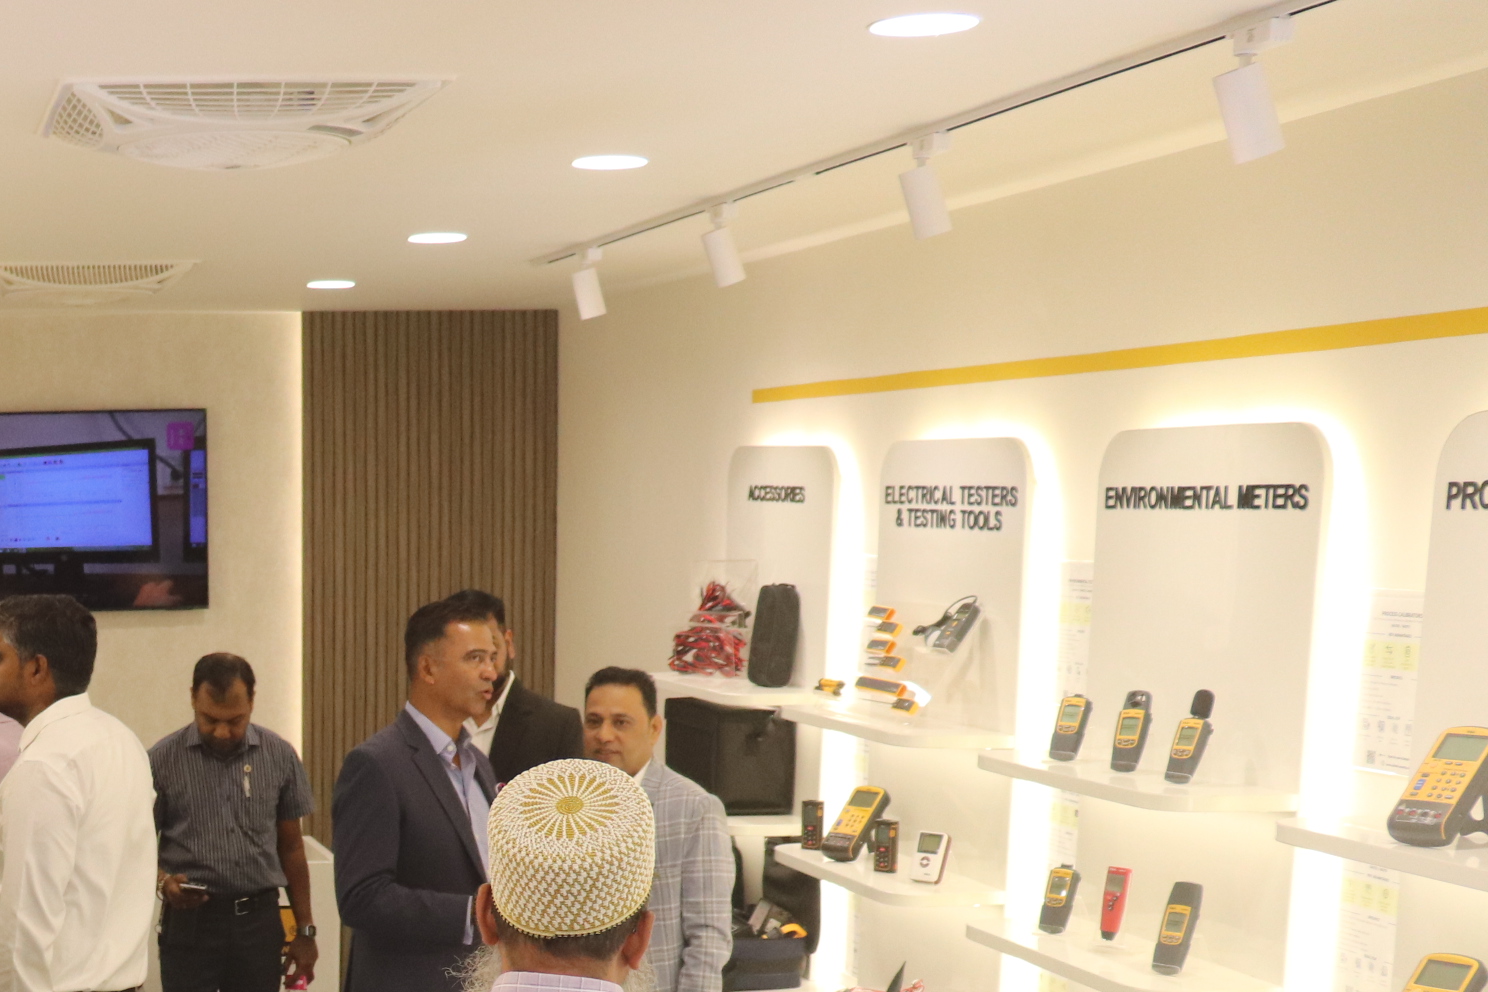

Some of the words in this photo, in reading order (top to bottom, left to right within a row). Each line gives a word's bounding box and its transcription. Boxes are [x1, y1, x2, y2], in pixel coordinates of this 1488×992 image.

[748, 485, 806, 503] ACCESSORIES
[885, 486, 956, 505] ELECTRICAL
[960, 486, 1019, 507] TESTERS
[1104, 485, 1234, 510] ENVIRONMENTAL
[1237, 484, 1310, 511] METERS
[896, 508, 904, 527] &
[907, 508, 957, 530] TESTING
[960, 510, 1003, 531] TOOLS
